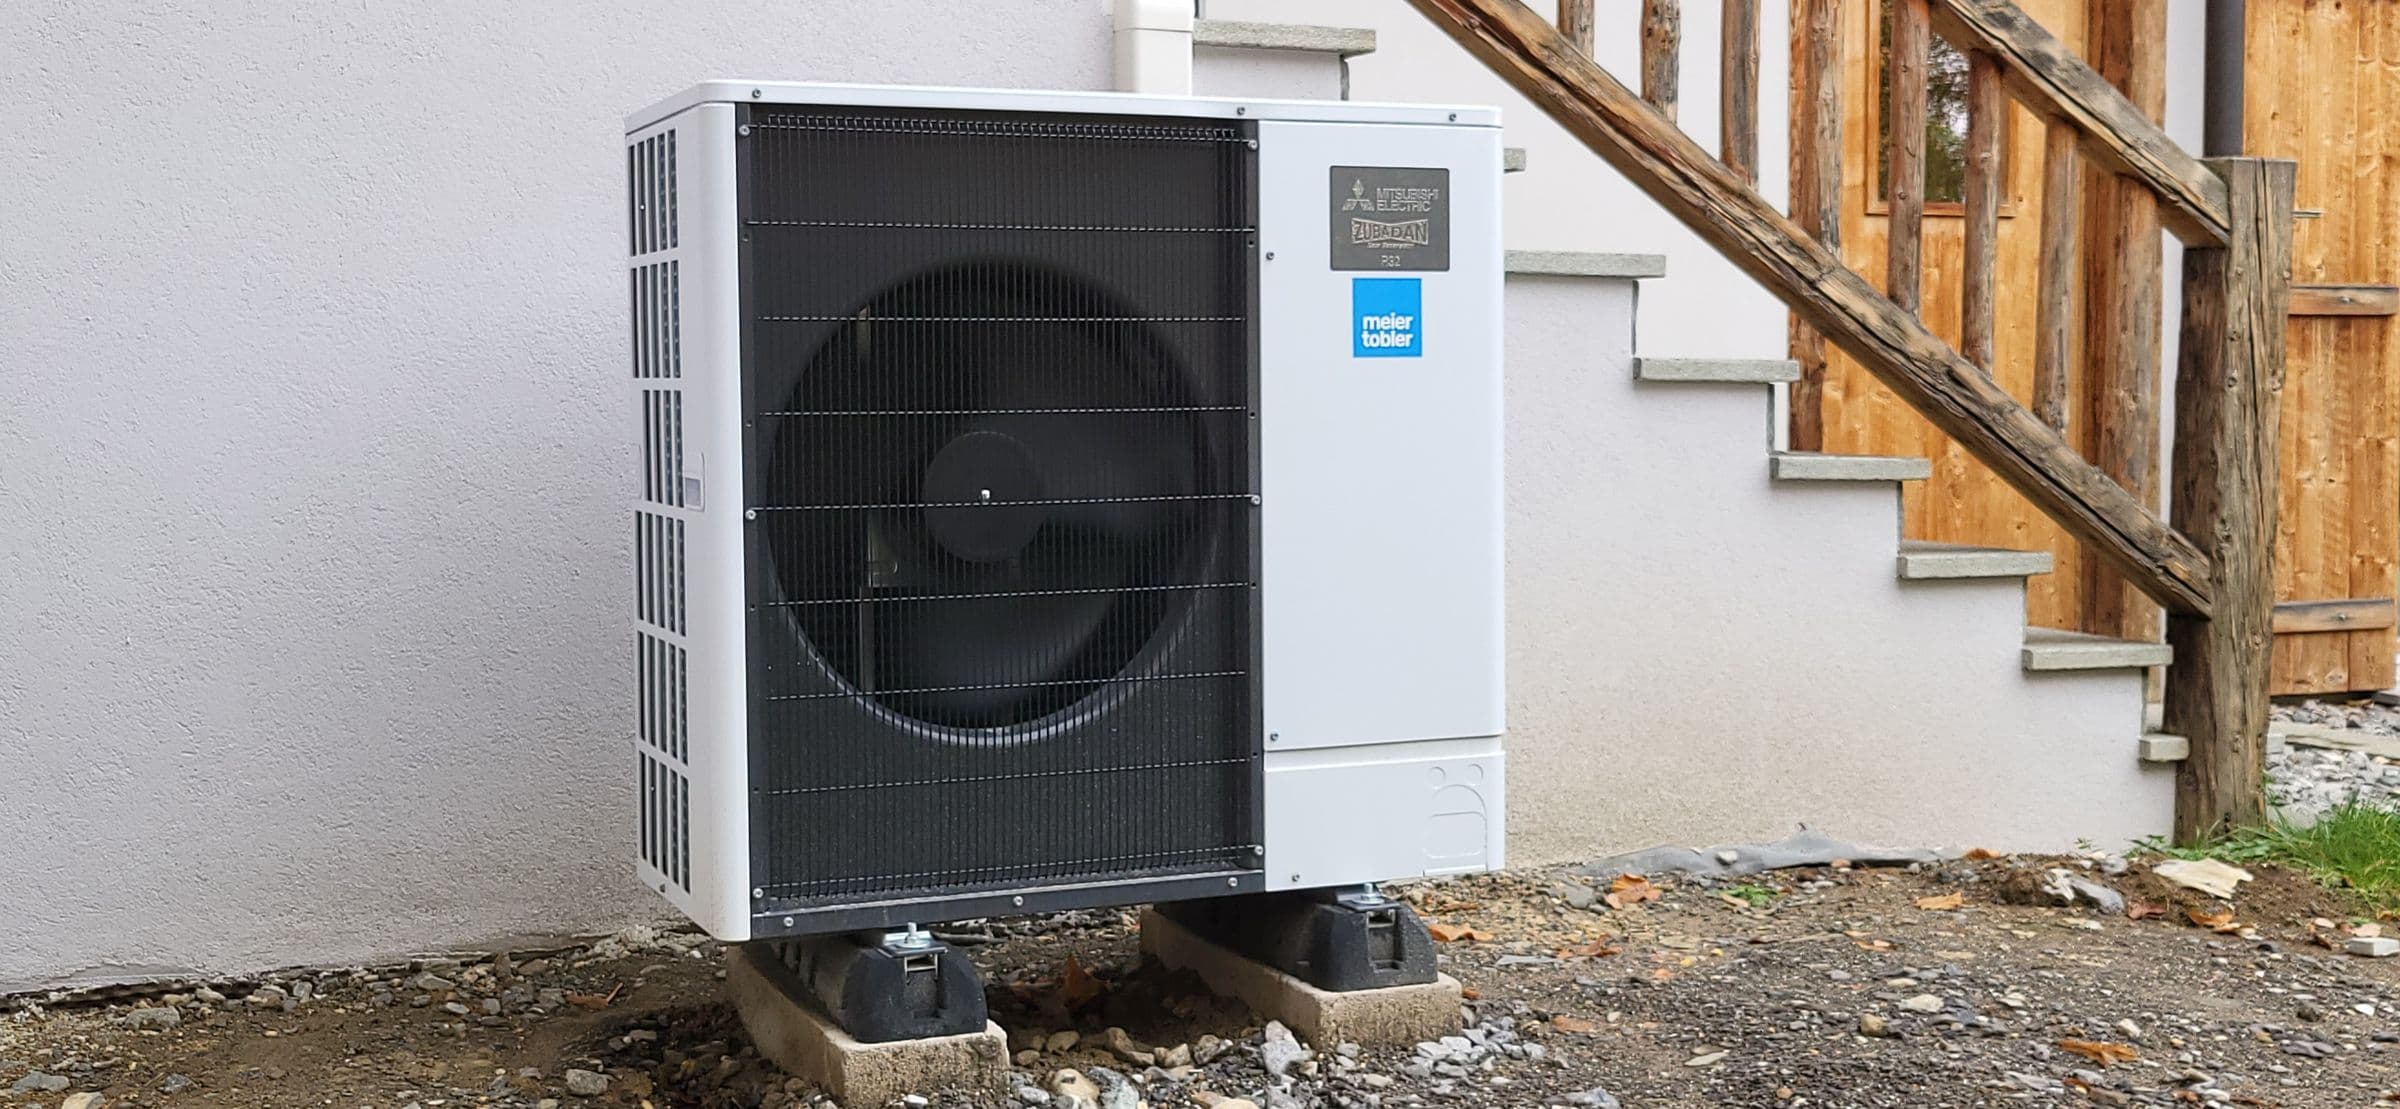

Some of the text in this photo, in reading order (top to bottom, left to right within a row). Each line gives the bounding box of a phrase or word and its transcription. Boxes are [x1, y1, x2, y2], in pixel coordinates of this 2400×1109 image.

[1376, 187, 1439, 200] MITSUBISHI
[1376, 200, 1431, 212] ELECTRIC
[1353, 221, 1426, 242] ZUBADAN
[1362, 312, 1414, 330] meier
[1361, 330, 1414, 348] tobler
